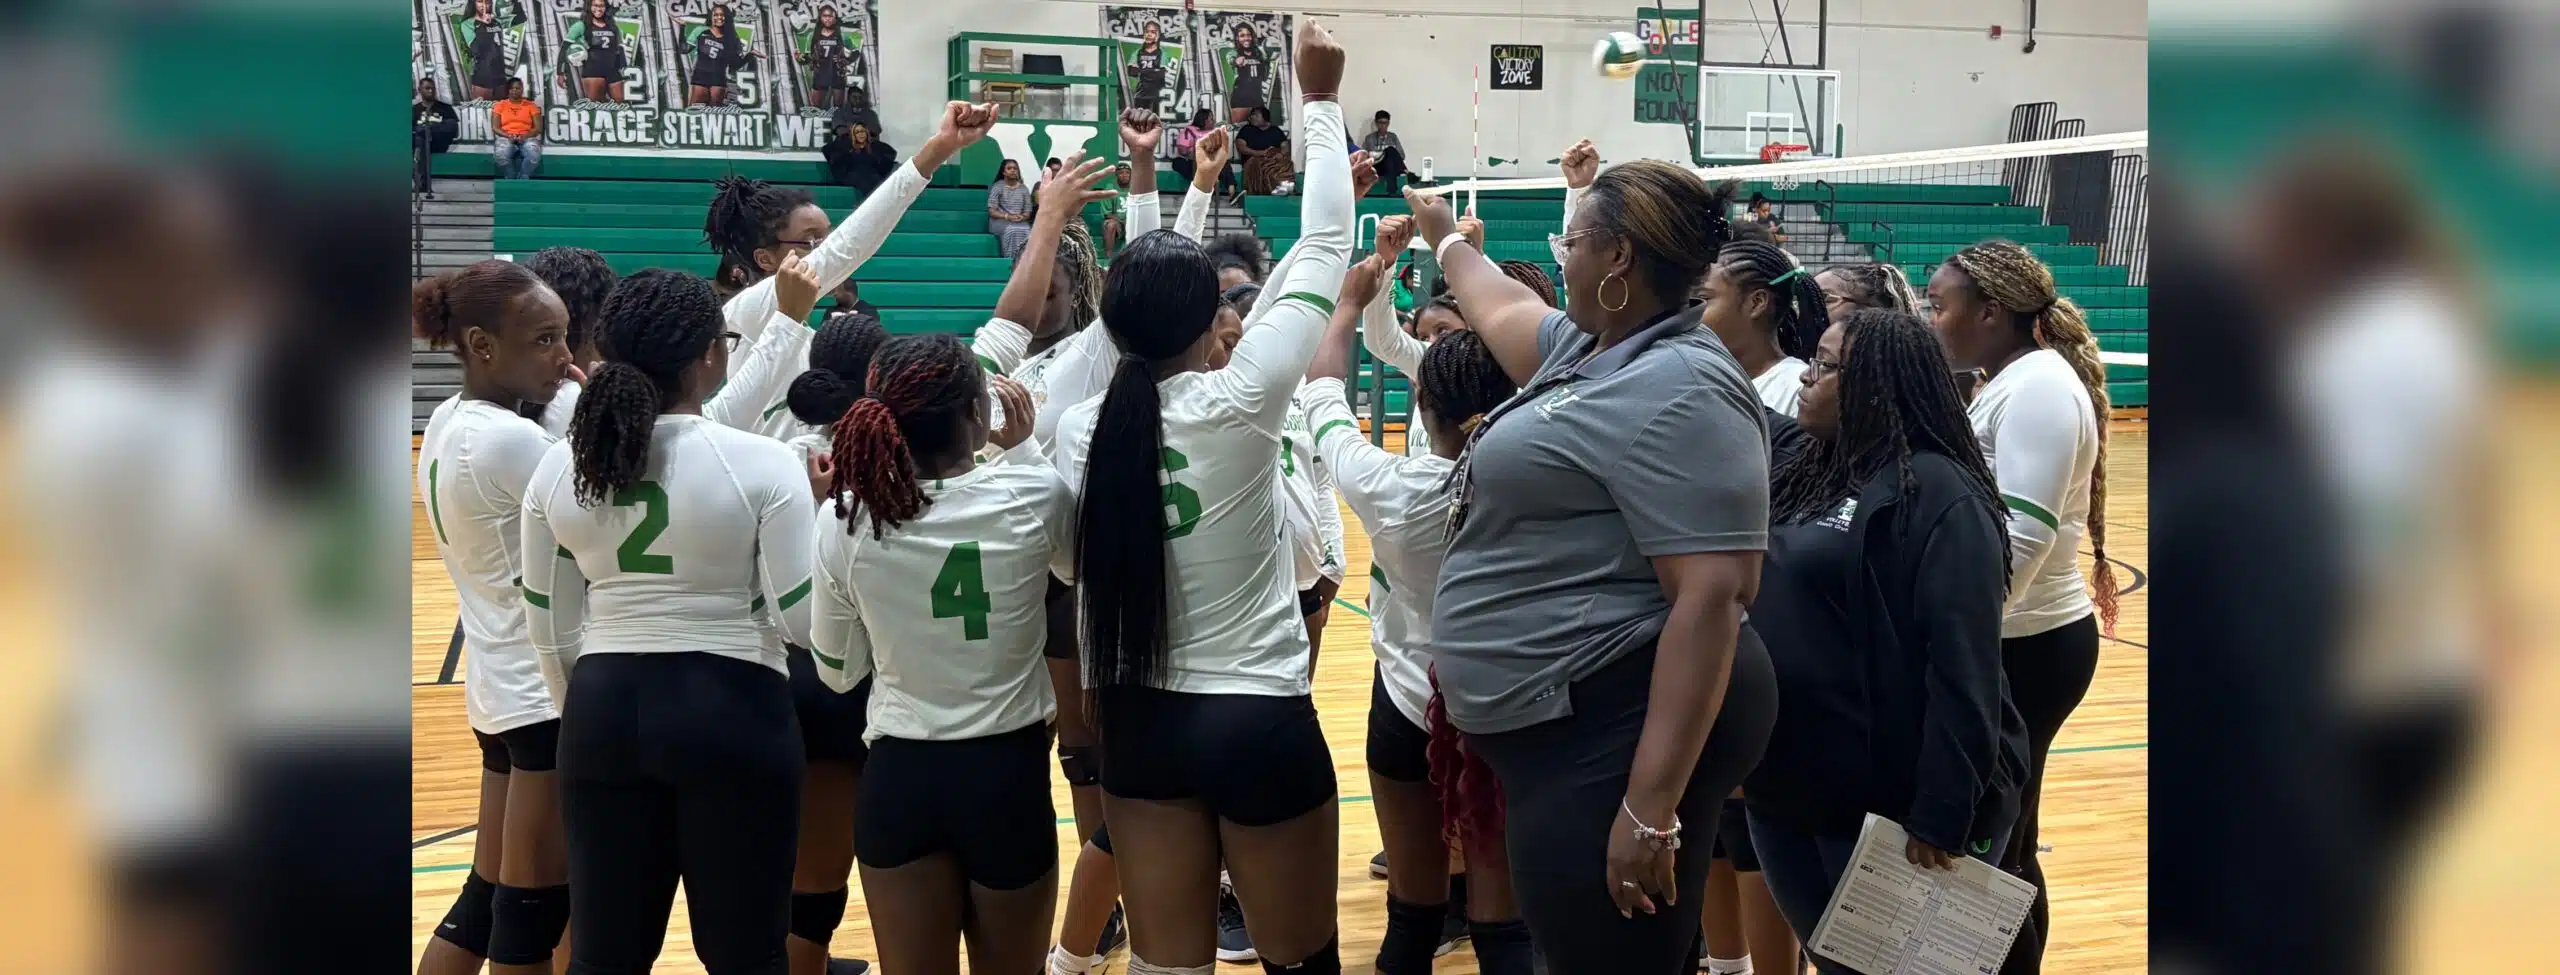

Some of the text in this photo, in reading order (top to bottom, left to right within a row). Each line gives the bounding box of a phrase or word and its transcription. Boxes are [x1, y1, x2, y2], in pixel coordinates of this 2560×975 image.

[1206, 20, 1283, 43] GARS
[1493, 46, 1541, 59] CAUTION
[1498, 58, 1535, 71] VICTORY
[623, 67, 645, 101] 2
[736, 71, 757, 106] 5
[1500, 70, 1533, 85] ZONE
[1645, 71, 1688, 92] NOT
[1158, 88, 1193, 121] 24
[548, 107, 655, 143] GRACE
[663, 111, 767, 147] STEWART
[612, 480, 675, 575] 2
[930, 540, 992, 642] 4
